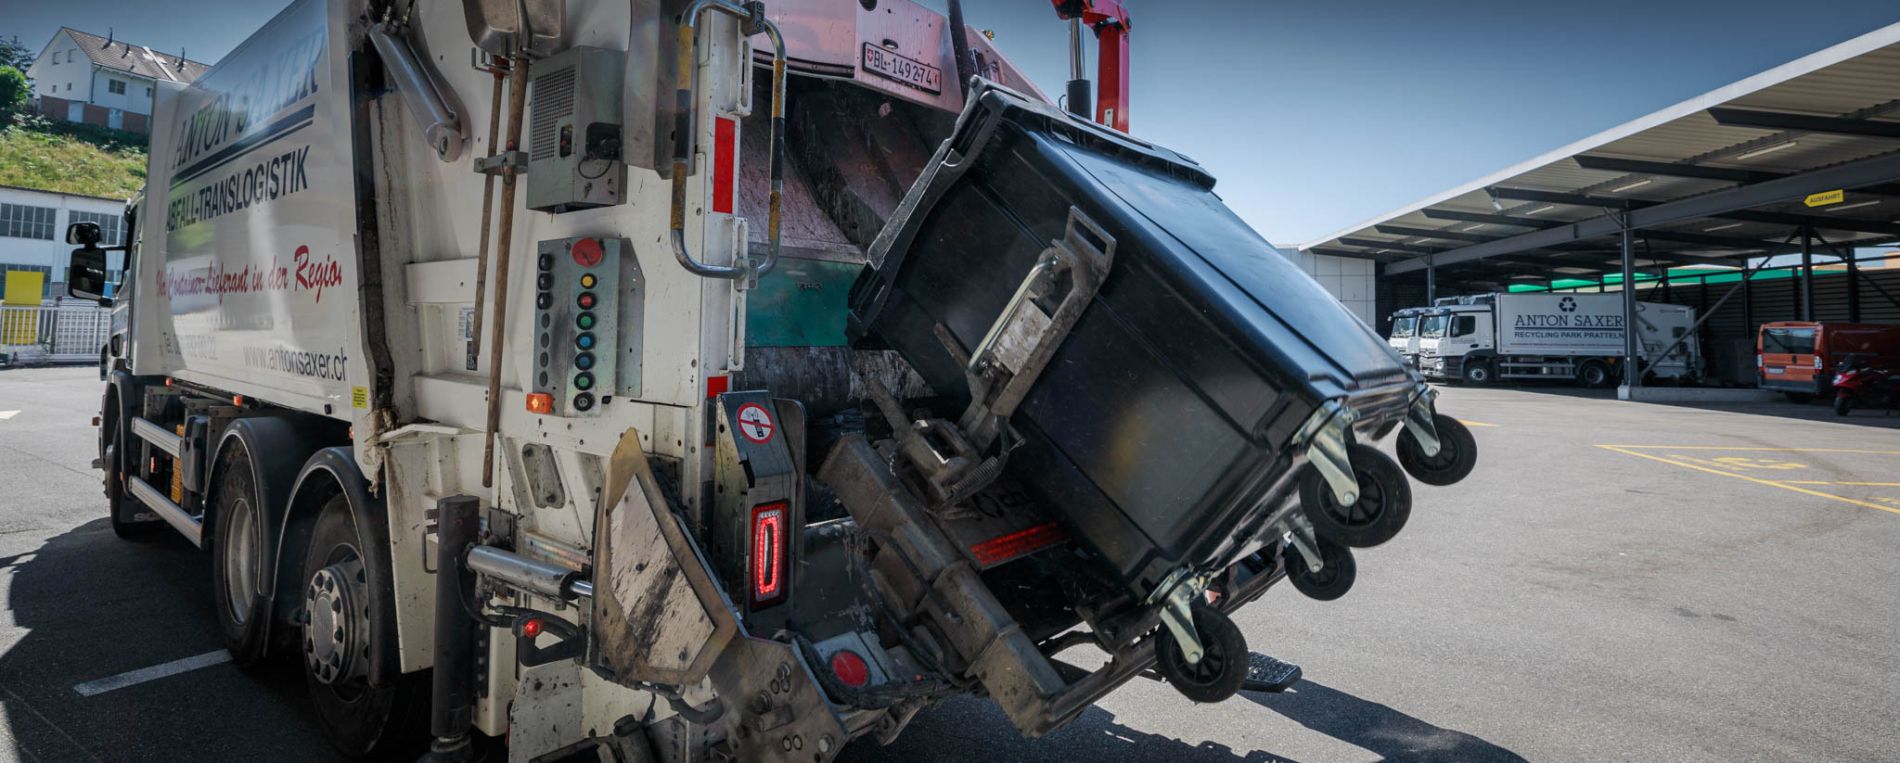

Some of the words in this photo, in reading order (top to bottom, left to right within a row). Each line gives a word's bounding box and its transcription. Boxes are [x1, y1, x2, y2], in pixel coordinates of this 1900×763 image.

[172, 91, 231, 169] ANTON
[167, 145, 310, 232] ABFALL-TRANSLOGISTIK
[252, 265, 264, 292] in
[268, 255, 288, 290] der
[1514, 331, 1559, 339] RECYCLING
[1560, 331, 1582, 339] PARK
[1584, 332, 1625, 340] PRATTELN
[1515, 314, 1568, 327] ANTON
[1574, 314, 1623, 327] SAXER
